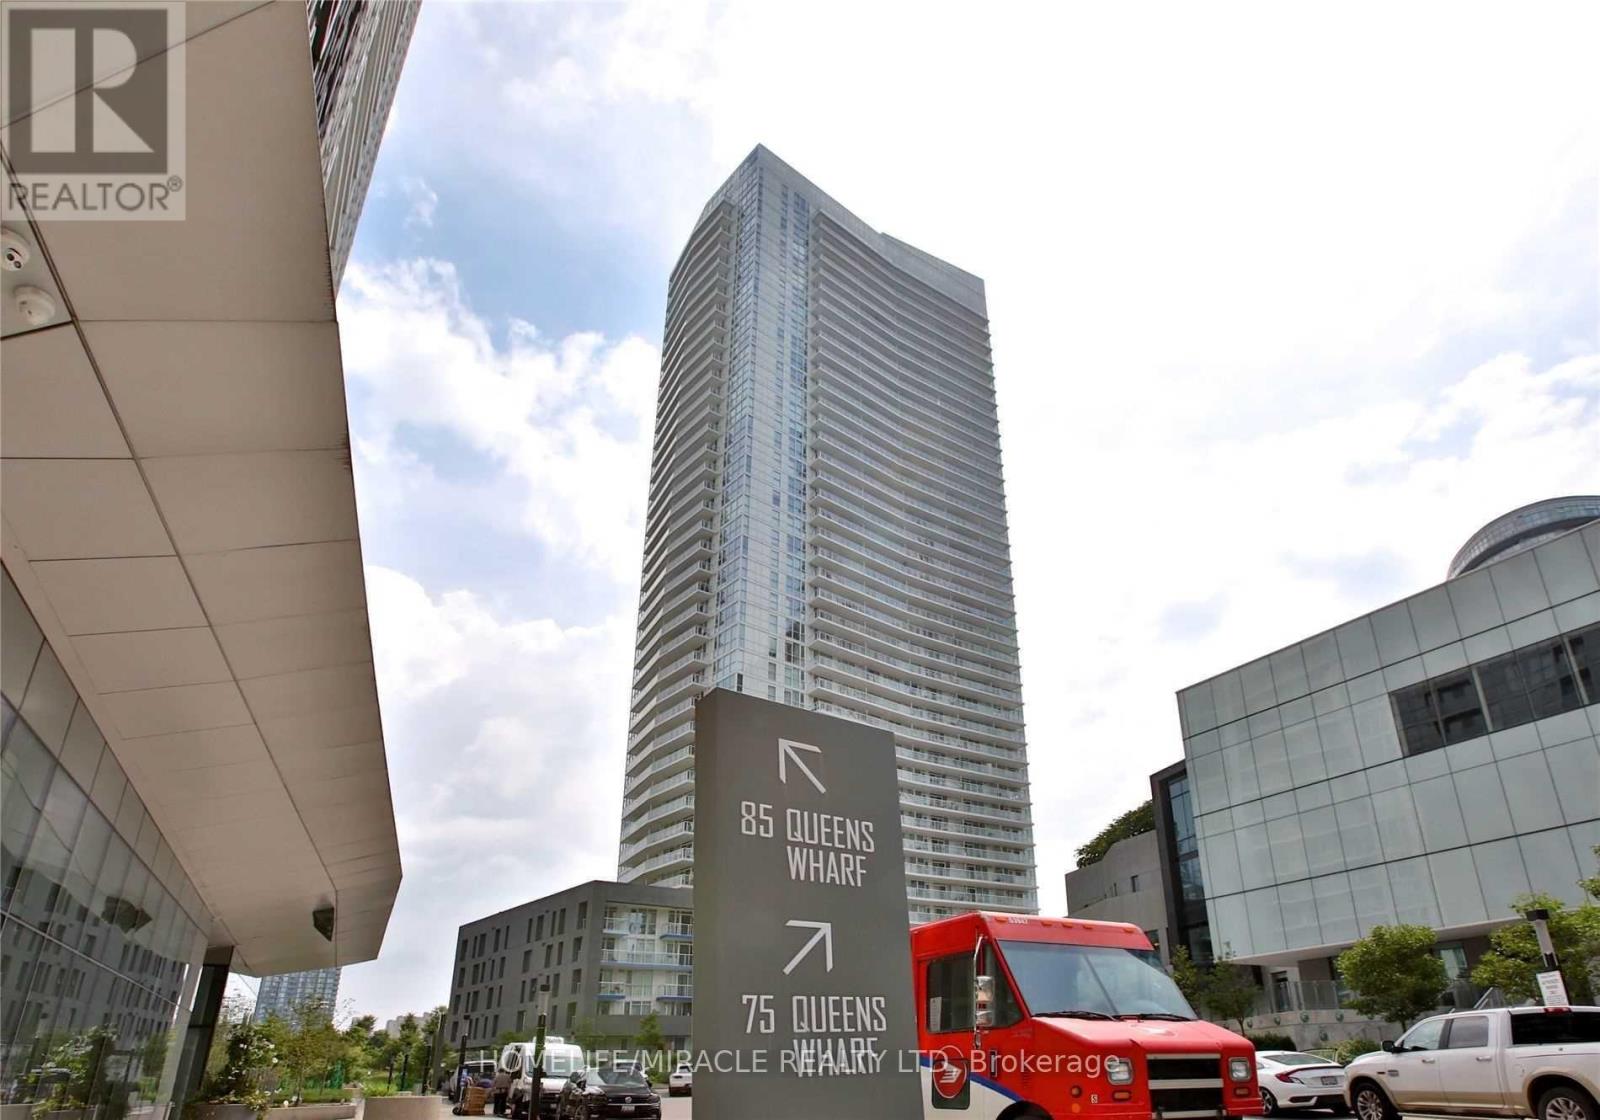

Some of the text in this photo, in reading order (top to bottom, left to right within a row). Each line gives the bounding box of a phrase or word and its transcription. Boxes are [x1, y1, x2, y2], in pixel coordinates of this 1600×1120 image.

[741, 800, 875, 853] 85 QUEENS
[786, 845, 867, 887] WHARF
[742, 994, 775, 1034] 75
[792, 995, 887, 1033] QUEENS
[793, 1037, 878, 1078] WHARF
